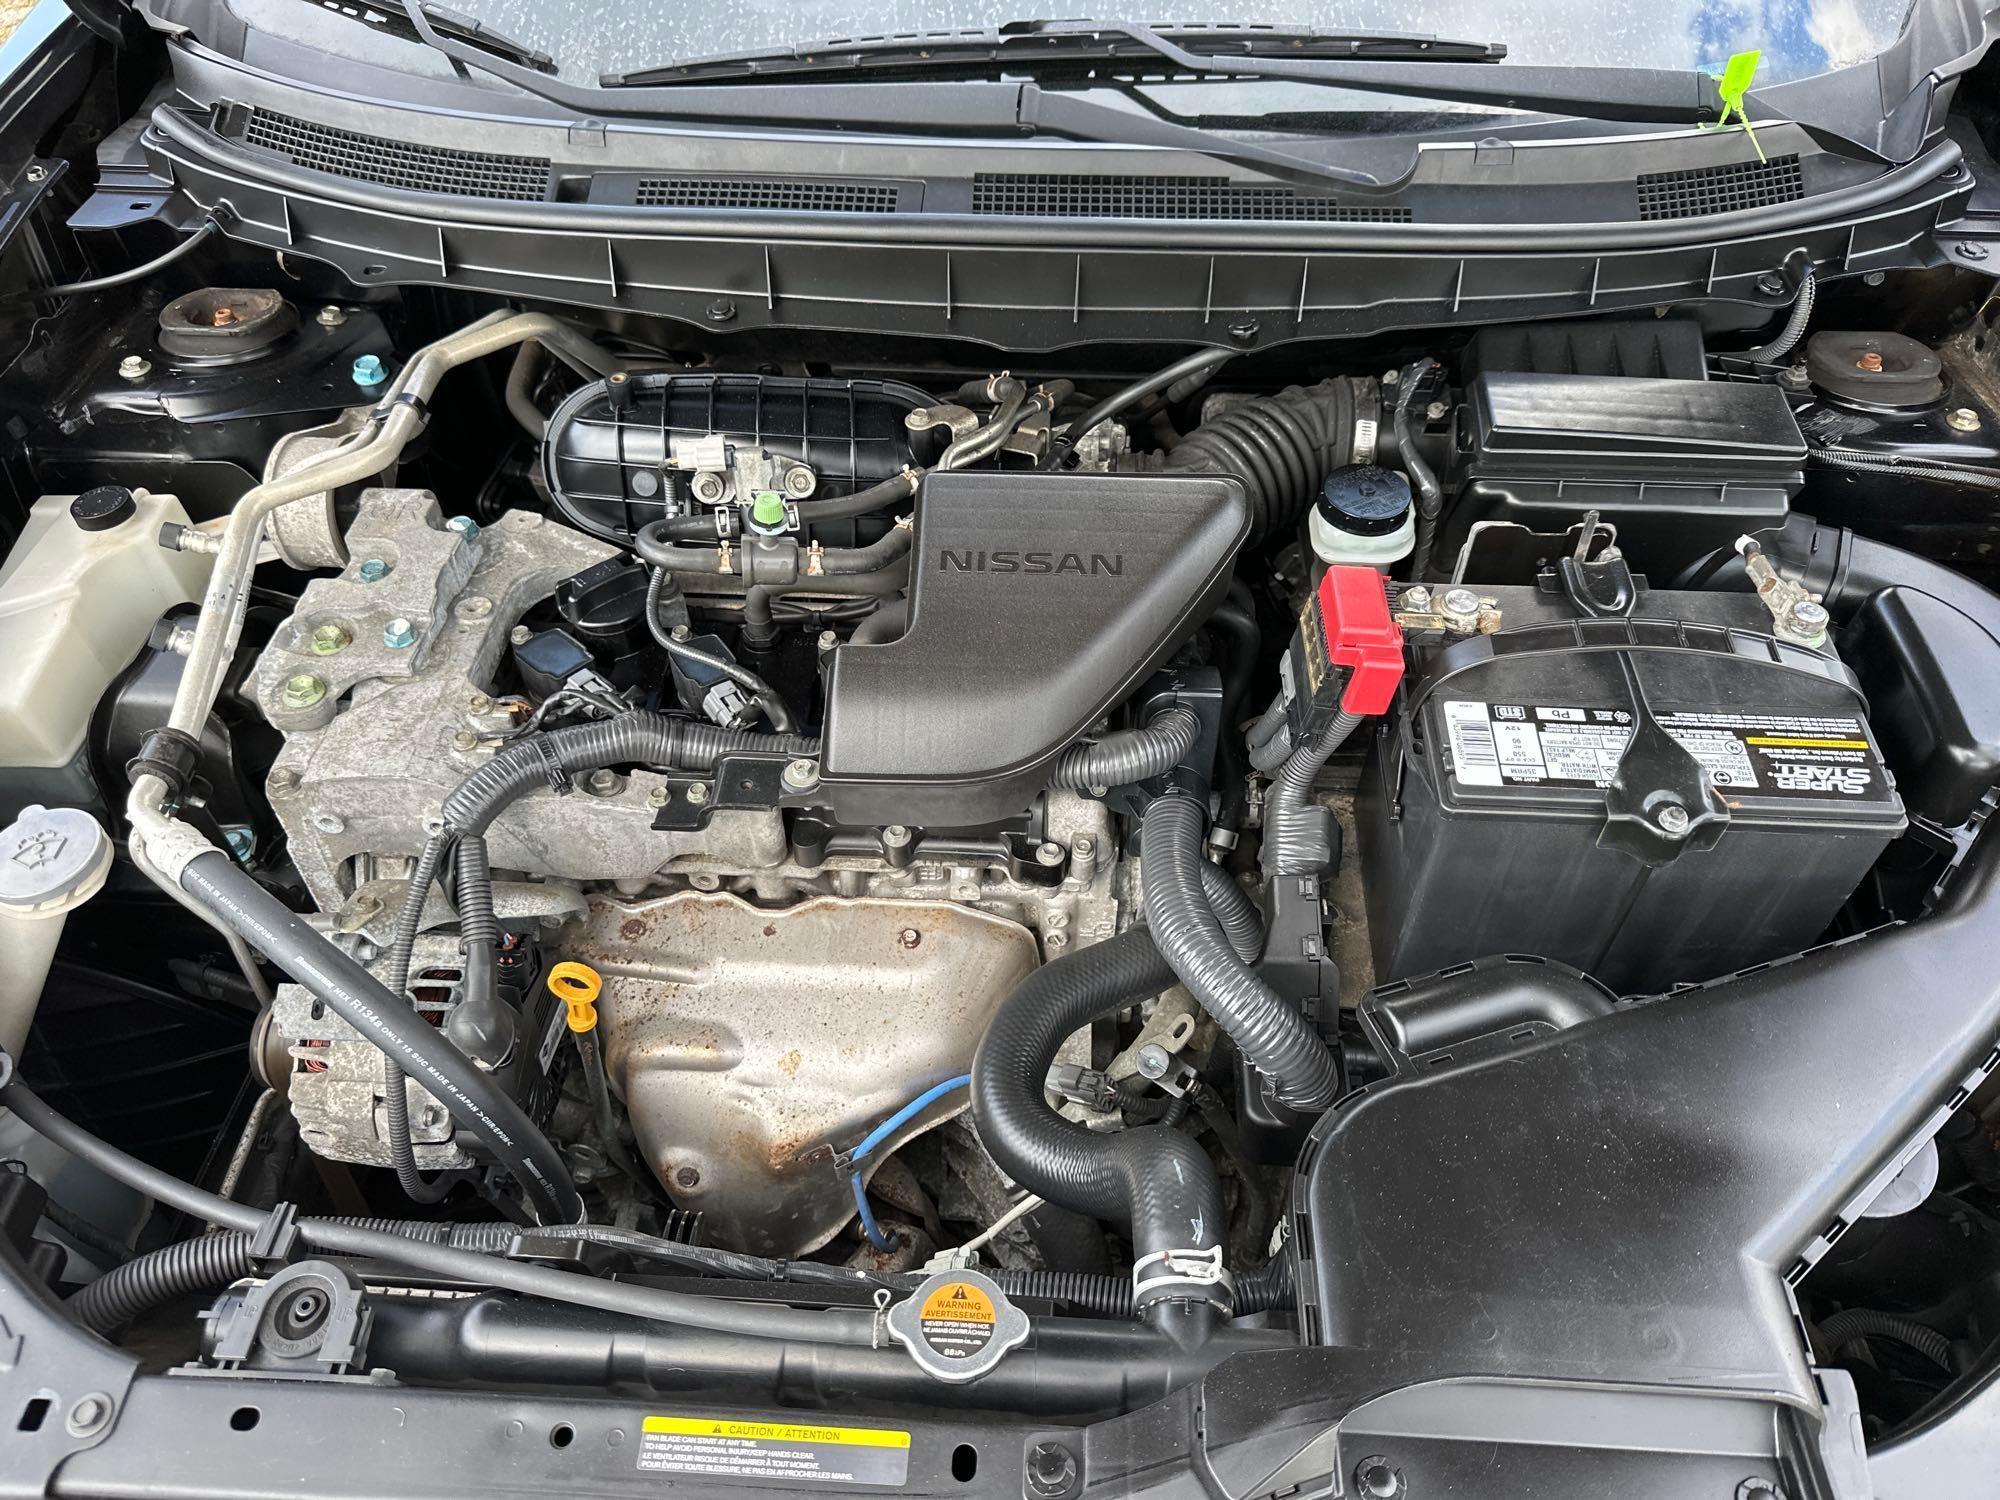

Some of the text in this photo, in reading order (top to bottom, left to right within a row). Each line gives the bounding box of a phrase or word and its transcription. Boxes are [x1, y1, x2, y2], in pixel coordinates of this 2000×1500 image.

[939, 550, 1123, 577] NISSAN
[1551, 708, 1570, 718] Pb
[1776, 764, 1871, 784] START
[1776, 776, 1864, 794] SUPER
[350, 998, 383, 1028] R134a
[381, 1026, 404, 1044] ONLY
[402, 1044, 413, 1054] 15
[411, 1052, 429, 1067] SUC
[426, 1066, 450, 1086] MADE
[447, 1084, 458, 1093] IN
[456, 1093, 479, 1112] JAPAN
[937, 1300, 981, 1310] WARNING
[925, 1310, 992, 1320] AVERTISSEMENT
[660, 1434, 681, 1442] BLADE
[729, 1425, 774, 1436] CAUTION
[784, 1428, 840, 1440] ATTENTION
[652, 1452, 693, 1461] VENTILATEUR
[694, 1455, 719, 1463] RISQUE
[672, 1444, 692, 1452] AVOID
[692, 1445, 728, 1454] PERSONAL
[791, 1451, 815, 1459] CLEAR.
[641, 1460, 660, 1468] POUR
[684, 1463, 705, 1471] TOUTE
